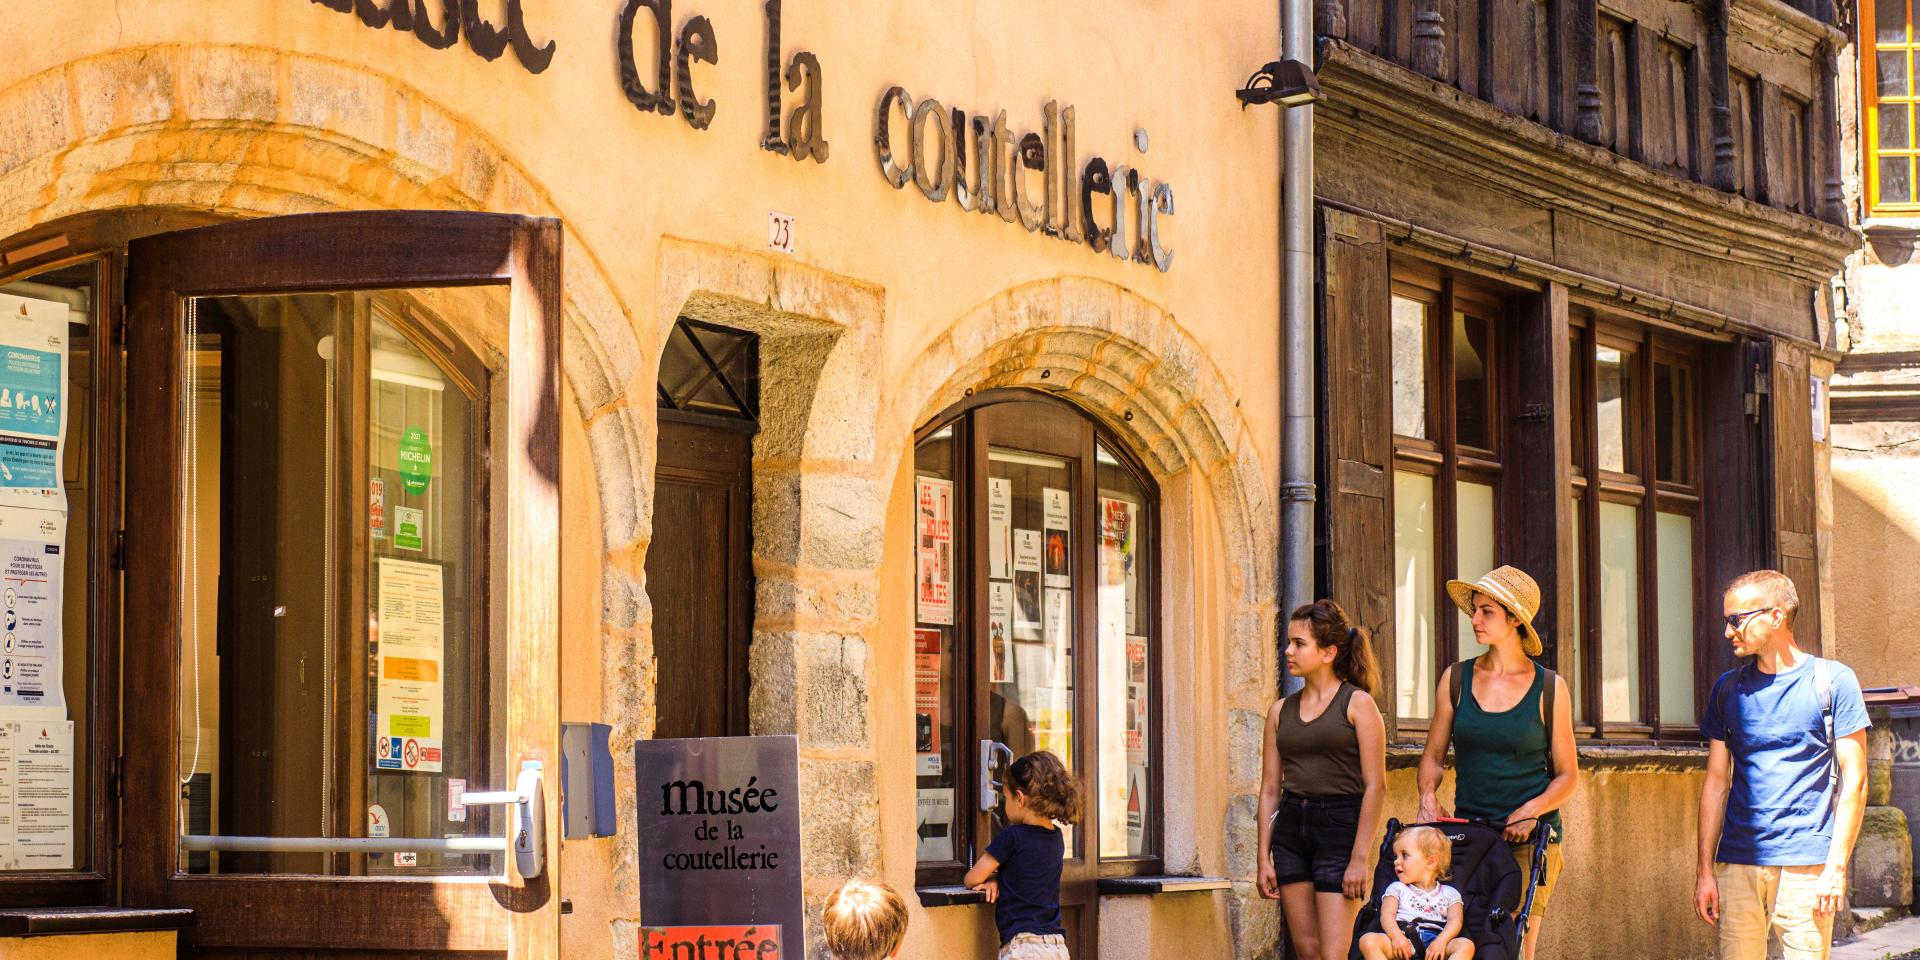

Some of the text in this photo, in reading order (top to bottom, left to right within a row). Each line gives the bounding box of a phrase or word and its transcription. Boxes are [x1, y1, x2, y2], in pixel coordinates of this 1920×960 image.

[619, 0, 718, 131] de
[760, 0, 829, 164] la
[875, 85, 1175, 273] coutellerie
[773, 217, 789, 249] 23
[400, 450, 431, 463] MICHELIN
[370, 481, 383, 496] 019
[920, 484, 931, 505] LES
[660, 775, 778, 816] Musée
[694, 820, 744, 841] de la
[663, 844, 778, 871] coutellerie
[640, 926, 778, 960] Entrée
